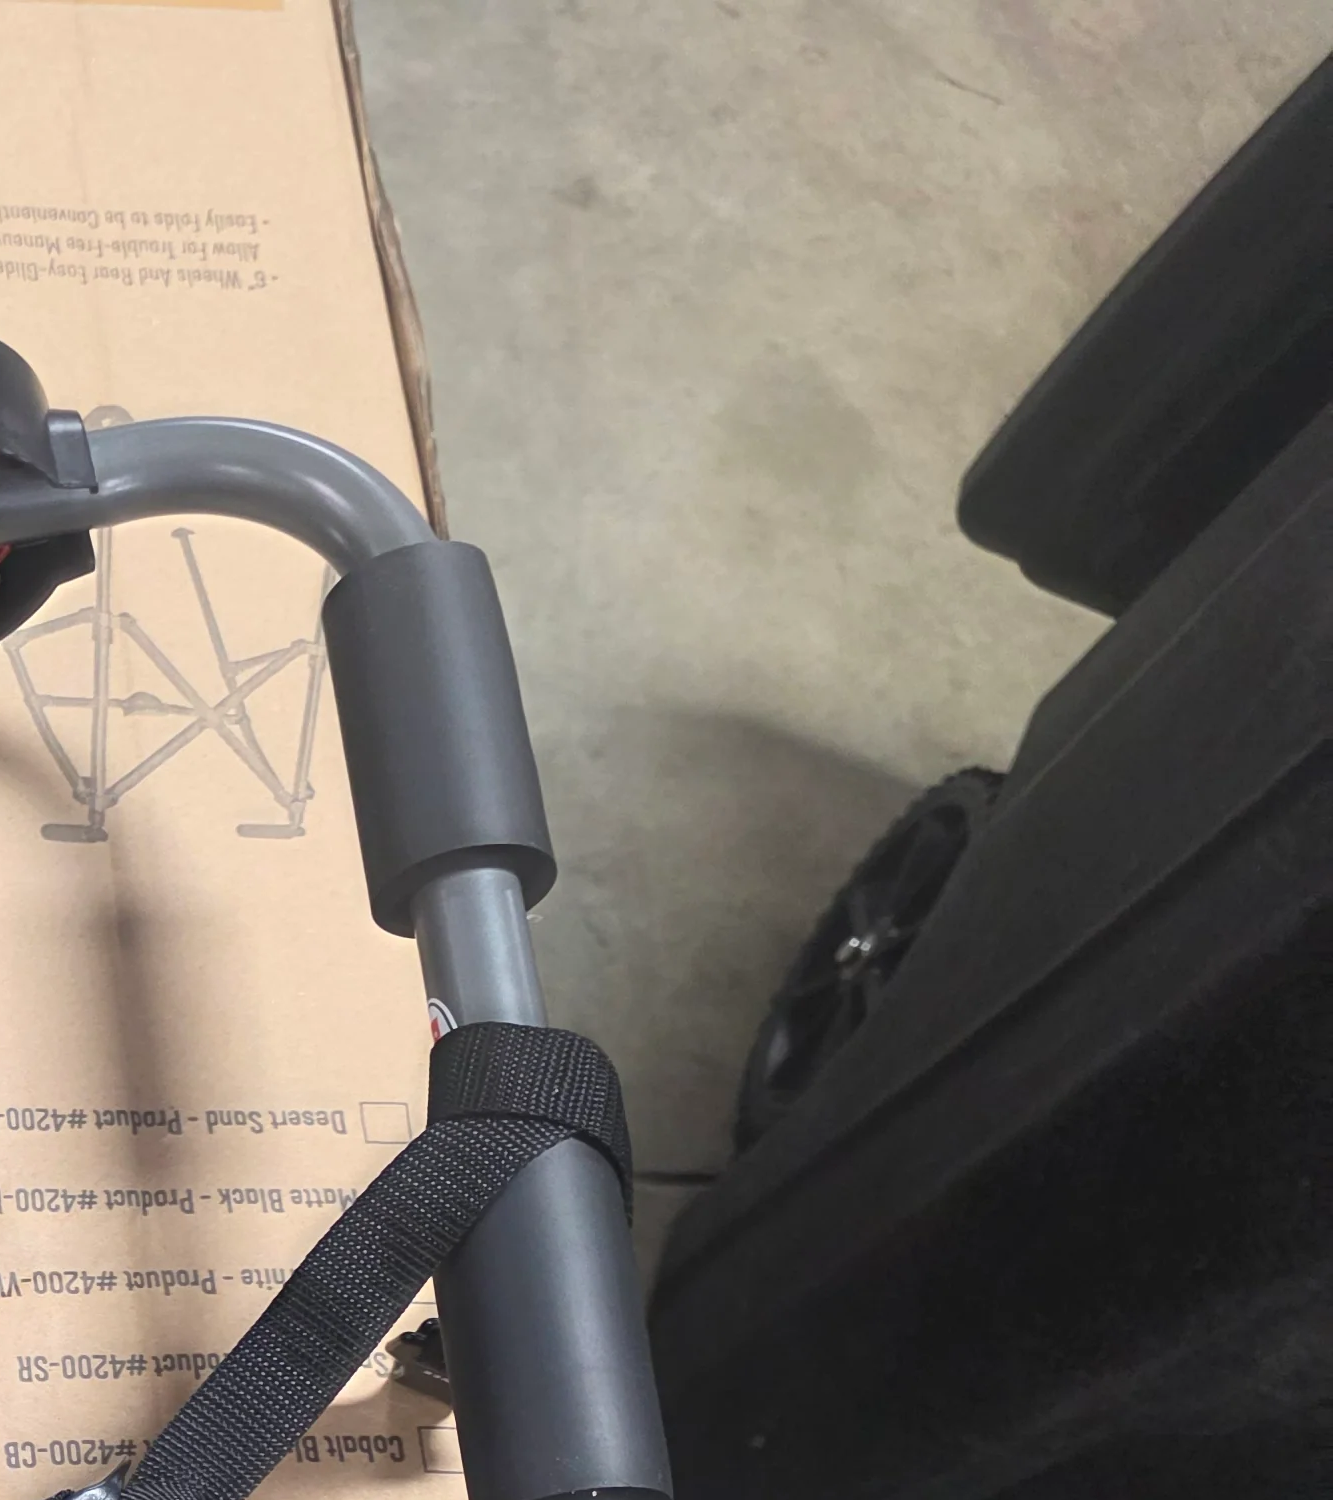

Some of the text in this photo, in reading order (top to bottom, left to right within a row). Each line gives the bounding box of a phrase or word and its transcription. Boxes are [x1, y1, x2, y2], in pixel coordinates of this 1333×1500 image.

[103, 209, 124, 228] be
[129, 210, 147, 228] to
[152, 211, 200, 232] Folds
[204, 208, 256, 233] Easily
[65, 235, 174, 260] Trouble-Free
[180, 240, 206, 260] For
[211, 240, 259, 261] Allow
[92, 264, 131, 285] Rear
[138, 266, 170, 287] And
[176, 267, 241, 288] Wheels
[92, 1107, 180, 1135] Product
[205, 1108, 261, 1134] Sand
[268, 1108, 346, 1135] Desert
[102, 1187, 193, 1215] Product
[216, 1187, 282, 1213] Black
[288, 1187, 357, 1213] Matte
[122, 1267, 215, 1296] Product
[239, 1266, 288, 1291] hite
[15, 1351, 229, 1382] oduct #4200-SR
[2, 1438, 136, 1469] #4200-CB
[322, 1433, 404, 1462] Cobalt
